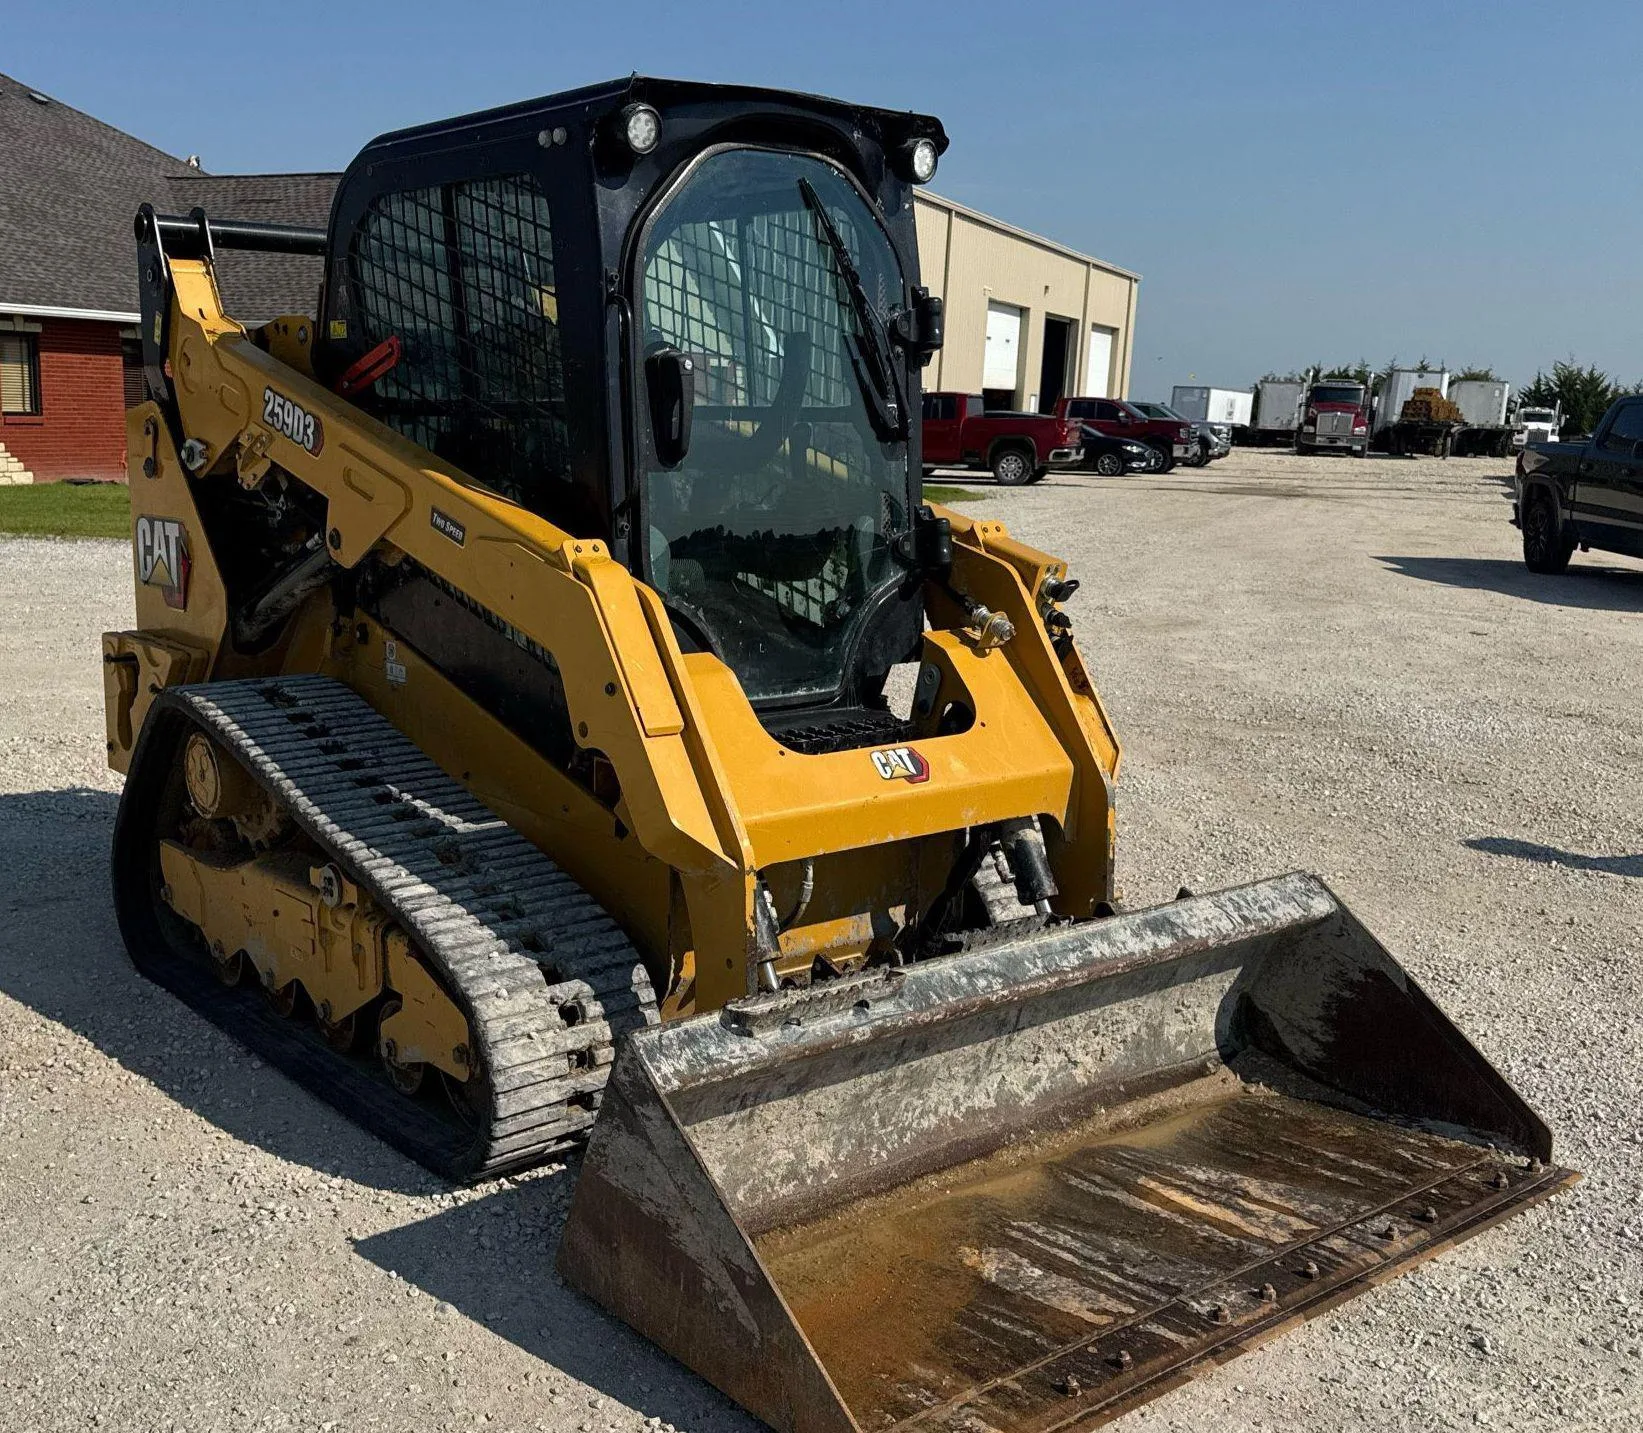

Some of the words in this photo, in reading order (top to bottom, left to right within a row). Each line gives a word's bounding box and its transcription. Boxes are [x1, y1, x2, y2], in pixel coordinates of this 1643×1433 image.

[263, 388, 315, 451] 259D3
[137, 516, 180, 588] CAT
[445, 521, 463, 541] SPEED
[870, 747, 917, 781] CAT
